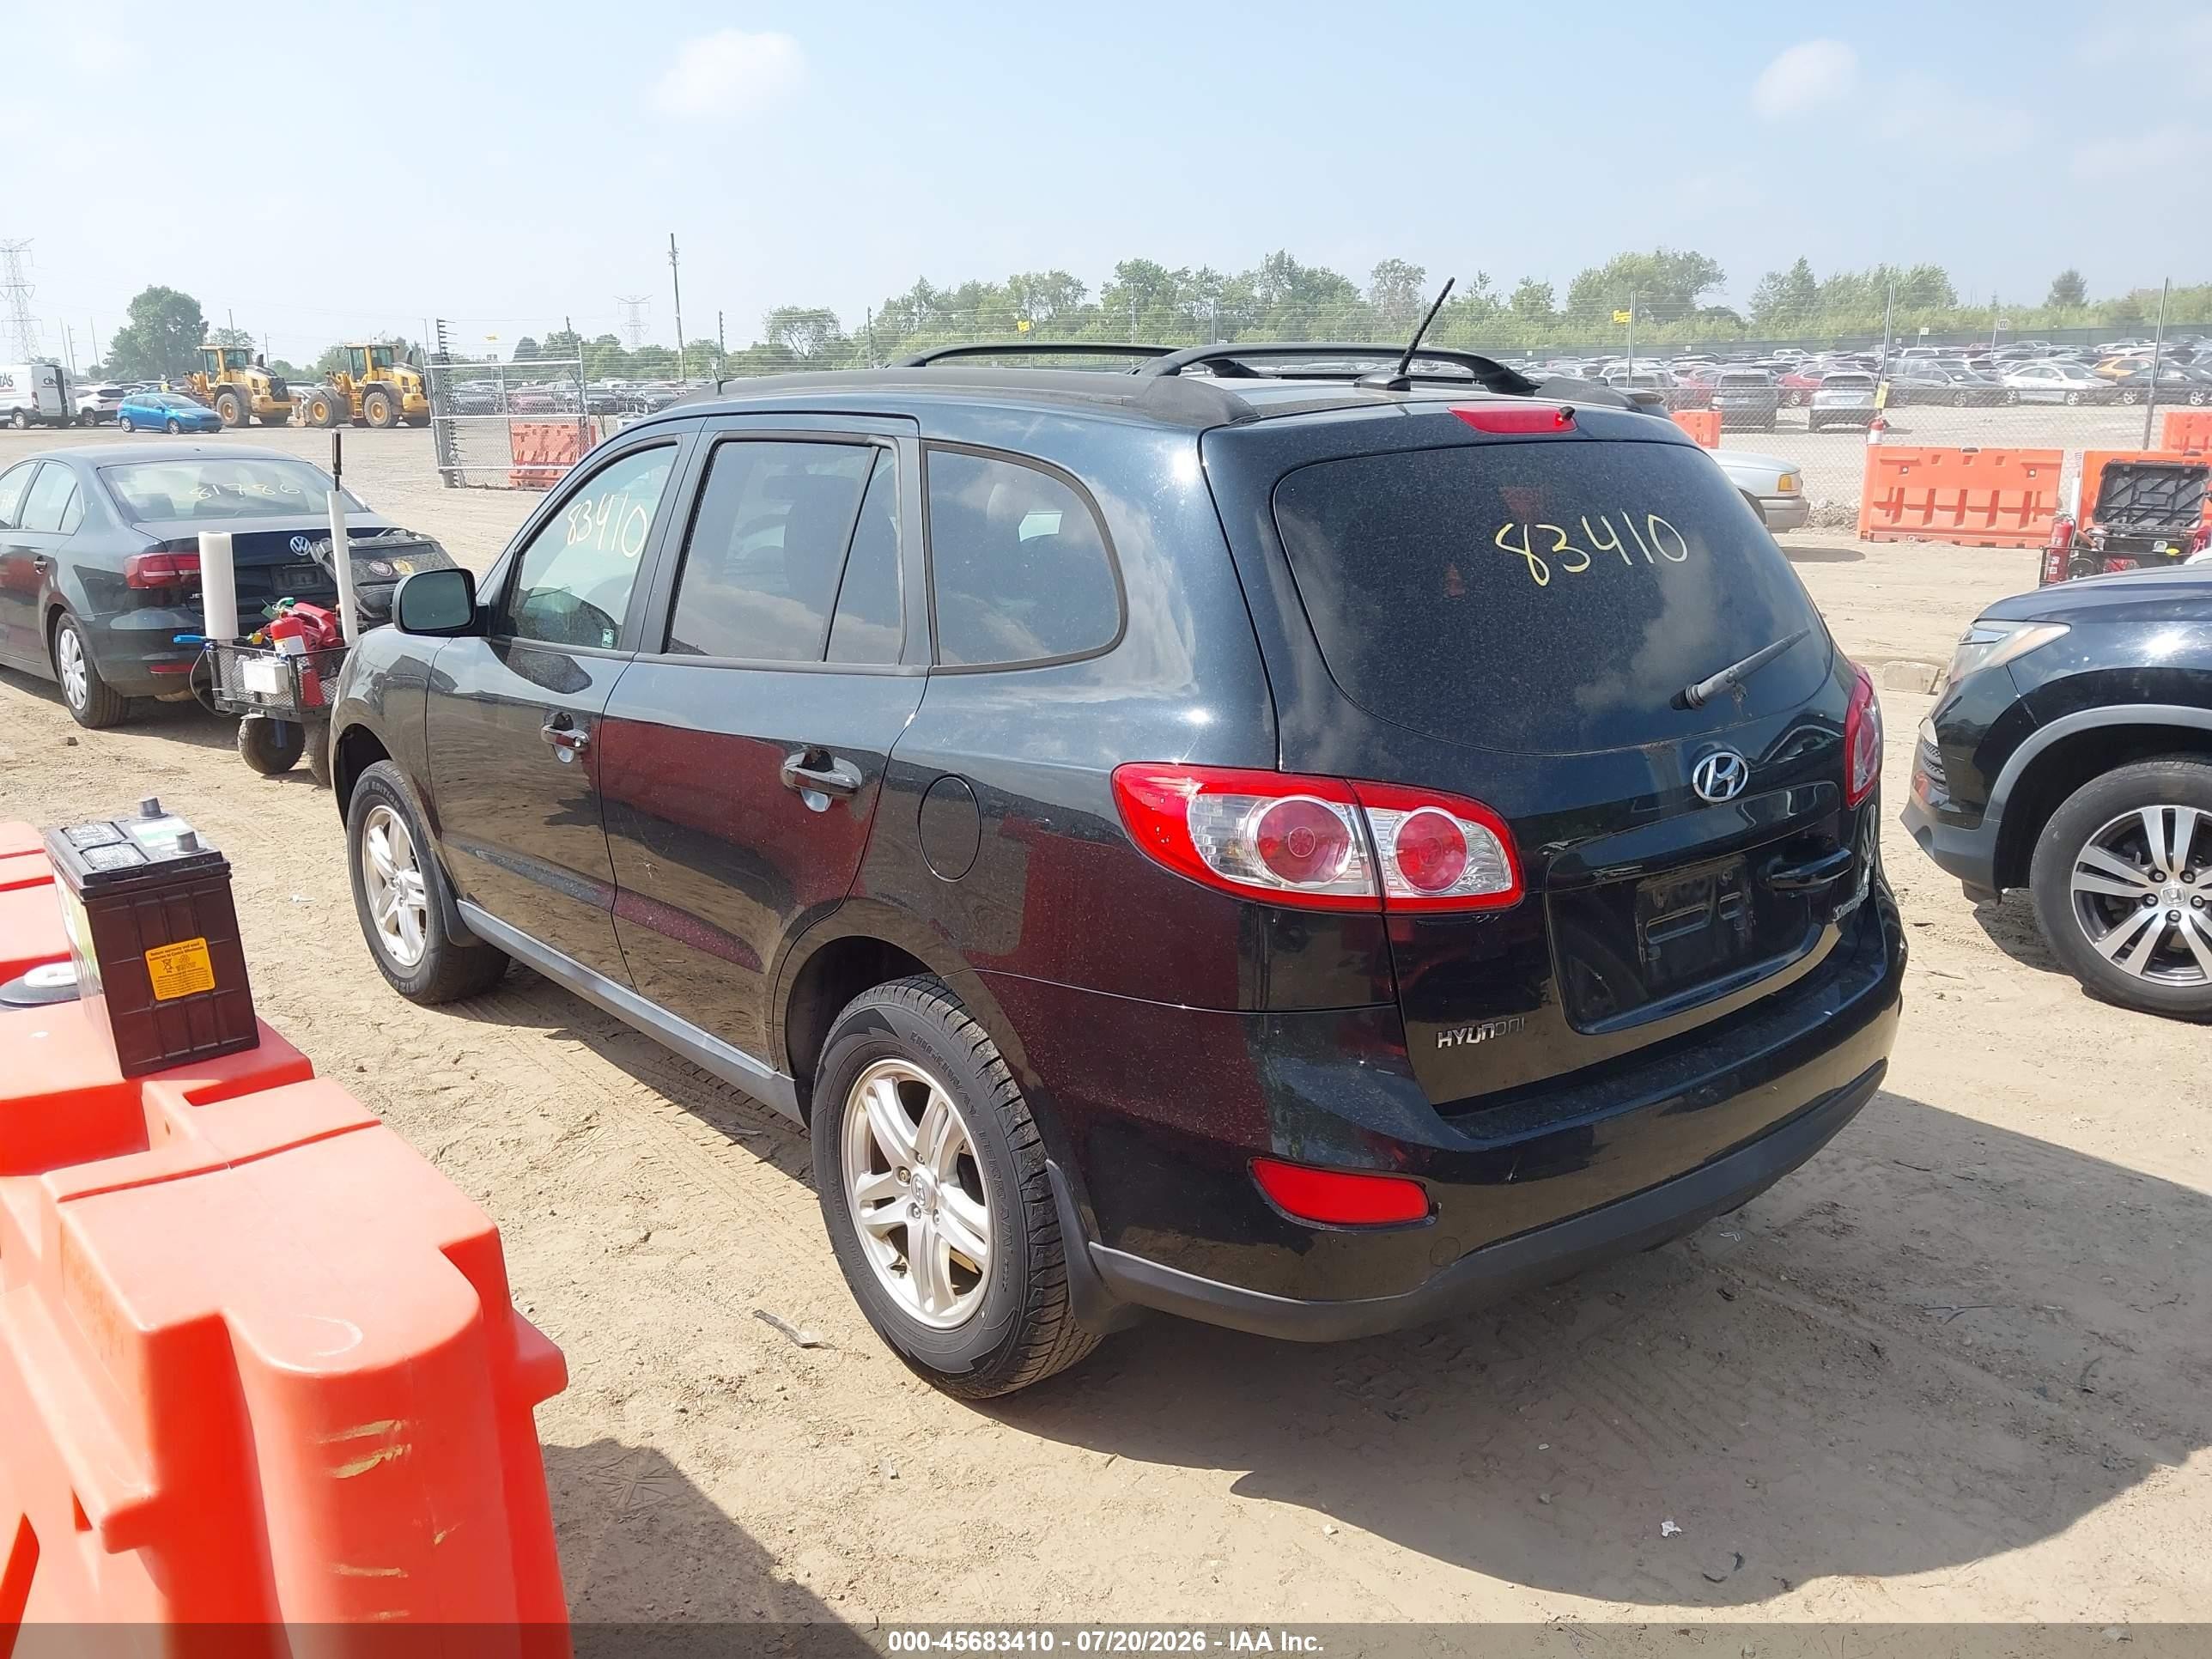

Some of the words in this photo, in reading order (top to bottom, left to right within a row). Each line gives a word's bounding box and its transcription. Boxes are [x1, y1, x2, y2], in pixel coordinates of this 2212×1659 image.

[189, 483, 301, 499] 81786
[567, 492, 647, 558] 83410
[1495, 508, 1688, 586] 83410
